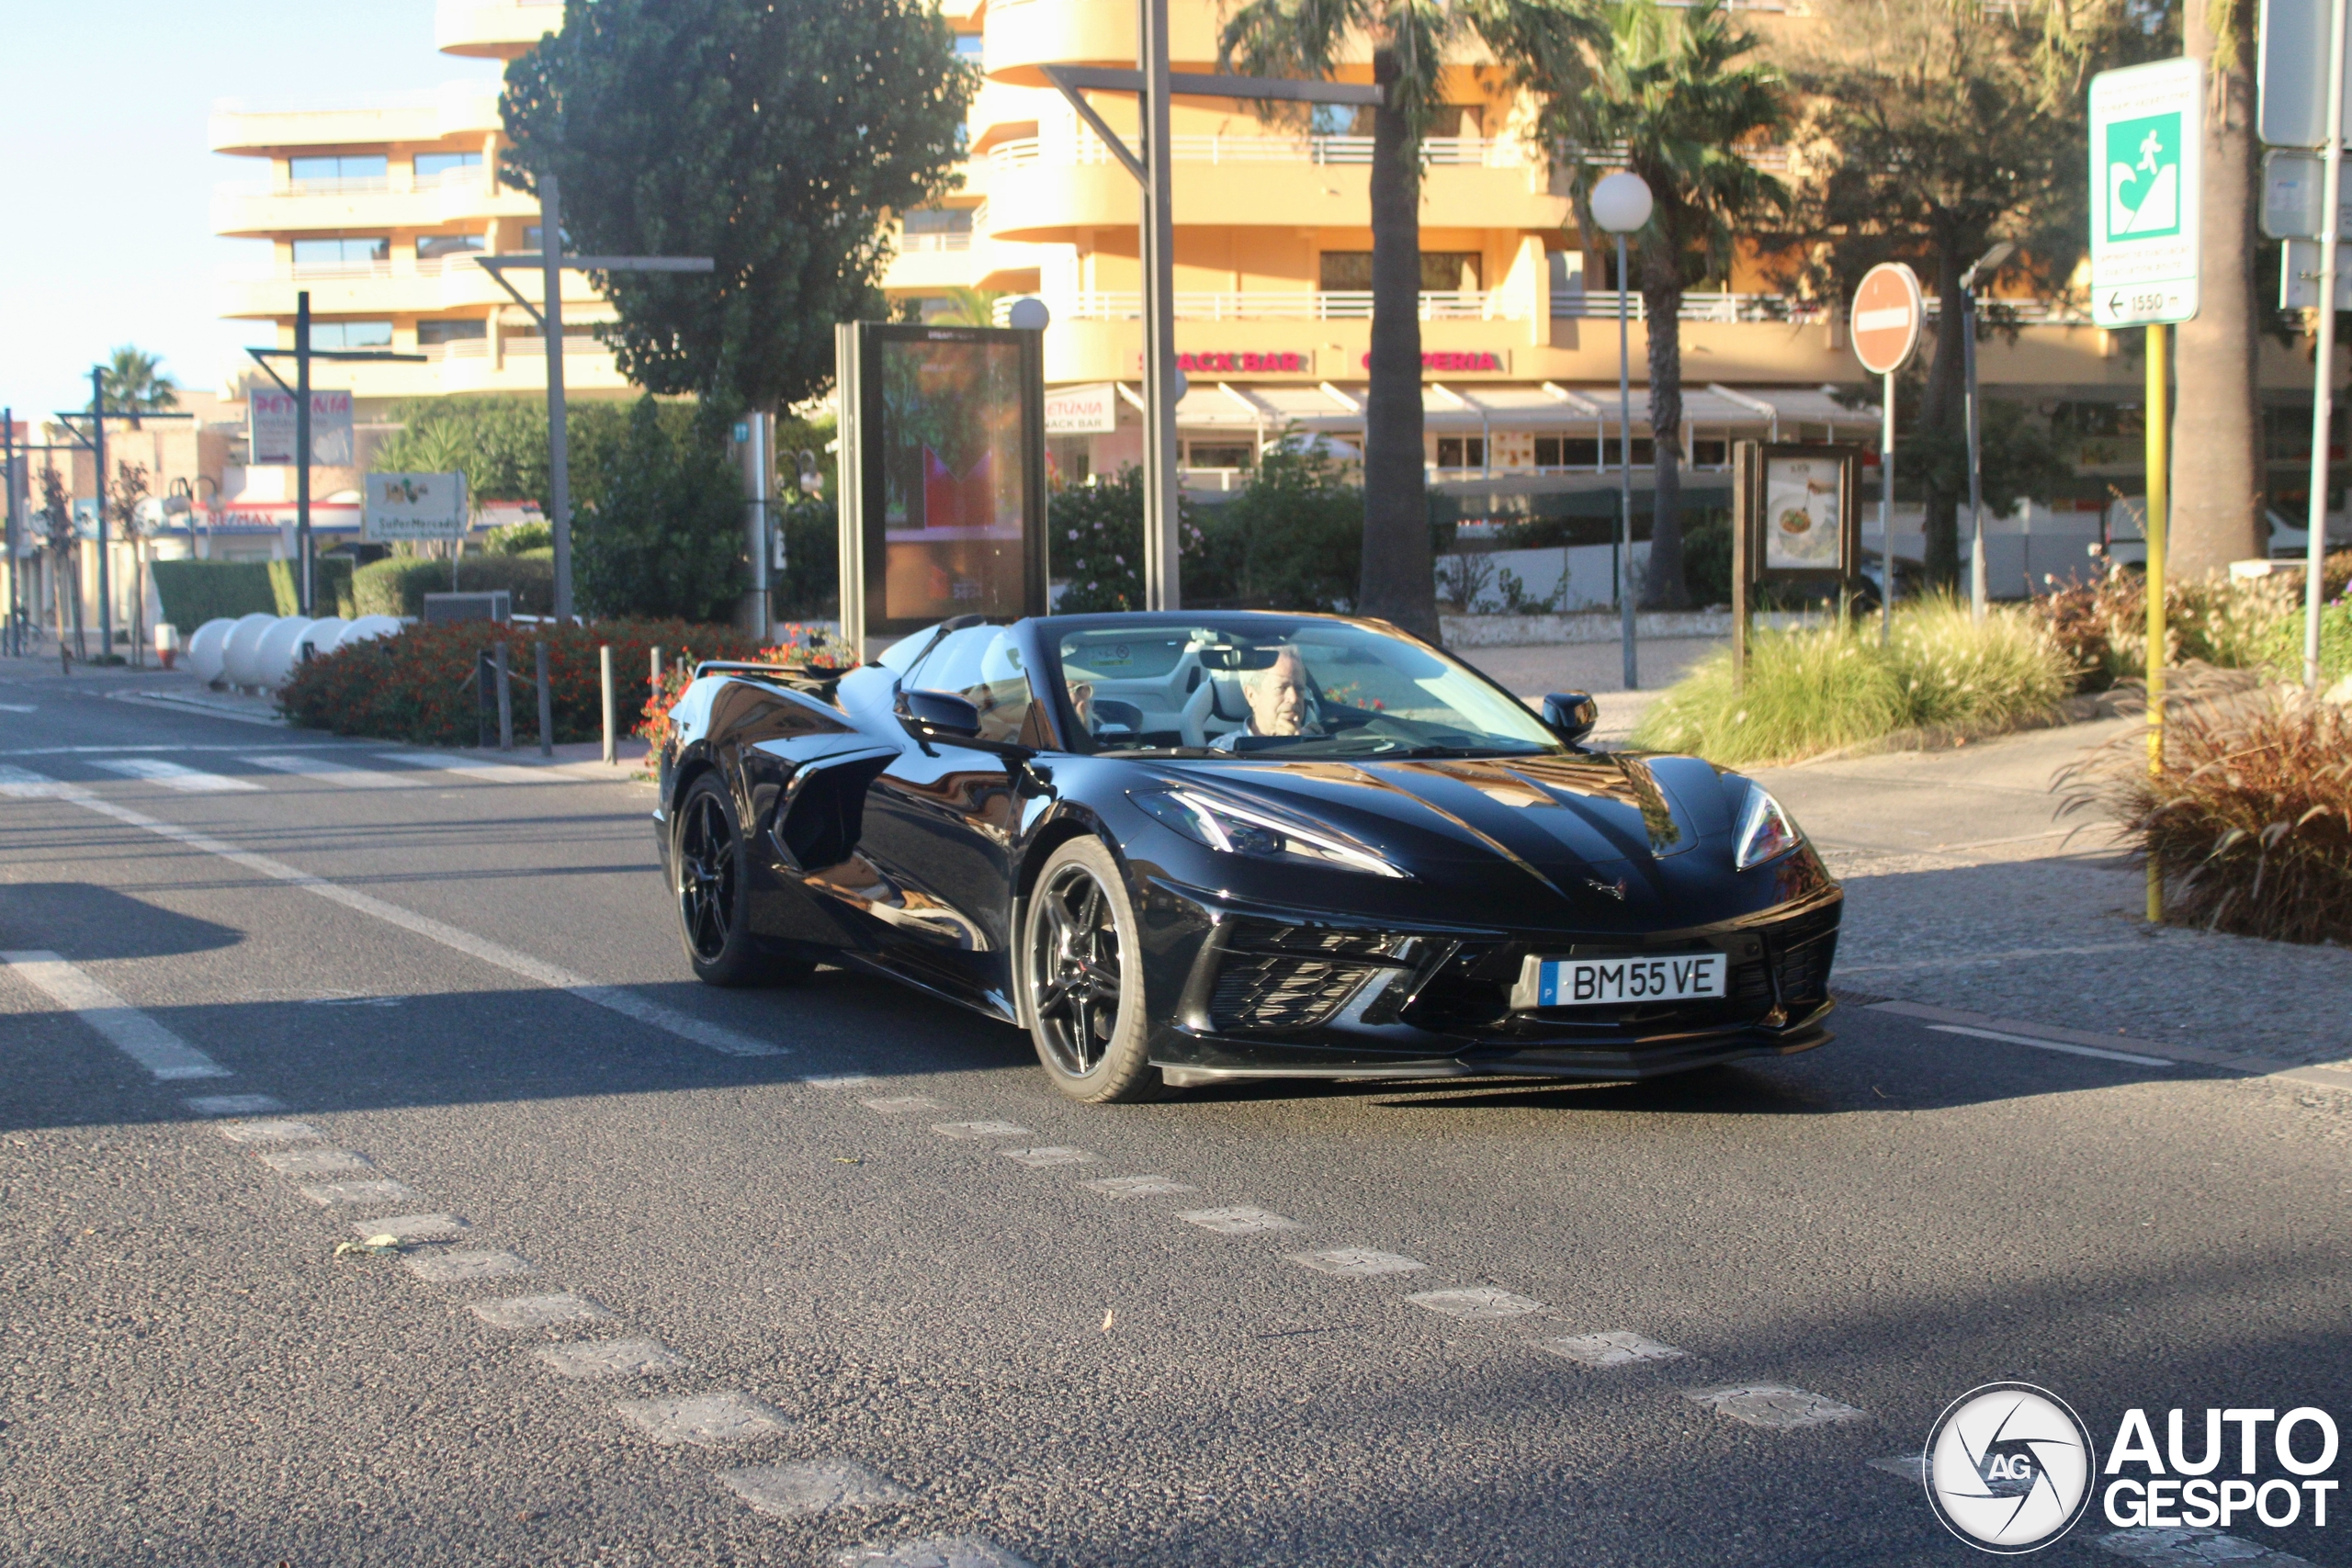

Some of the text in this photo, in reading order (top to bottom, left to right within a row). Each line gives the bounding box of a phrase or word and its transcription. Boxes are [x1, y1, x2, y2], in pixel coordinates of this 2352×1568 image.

[2132, 293, 2163, 312] 1550
[1139, 352, 1300, 371] ACK BAR
[255, 394, 348, 413] PETNIA
[1079, 418, 1102, 428] BAR
